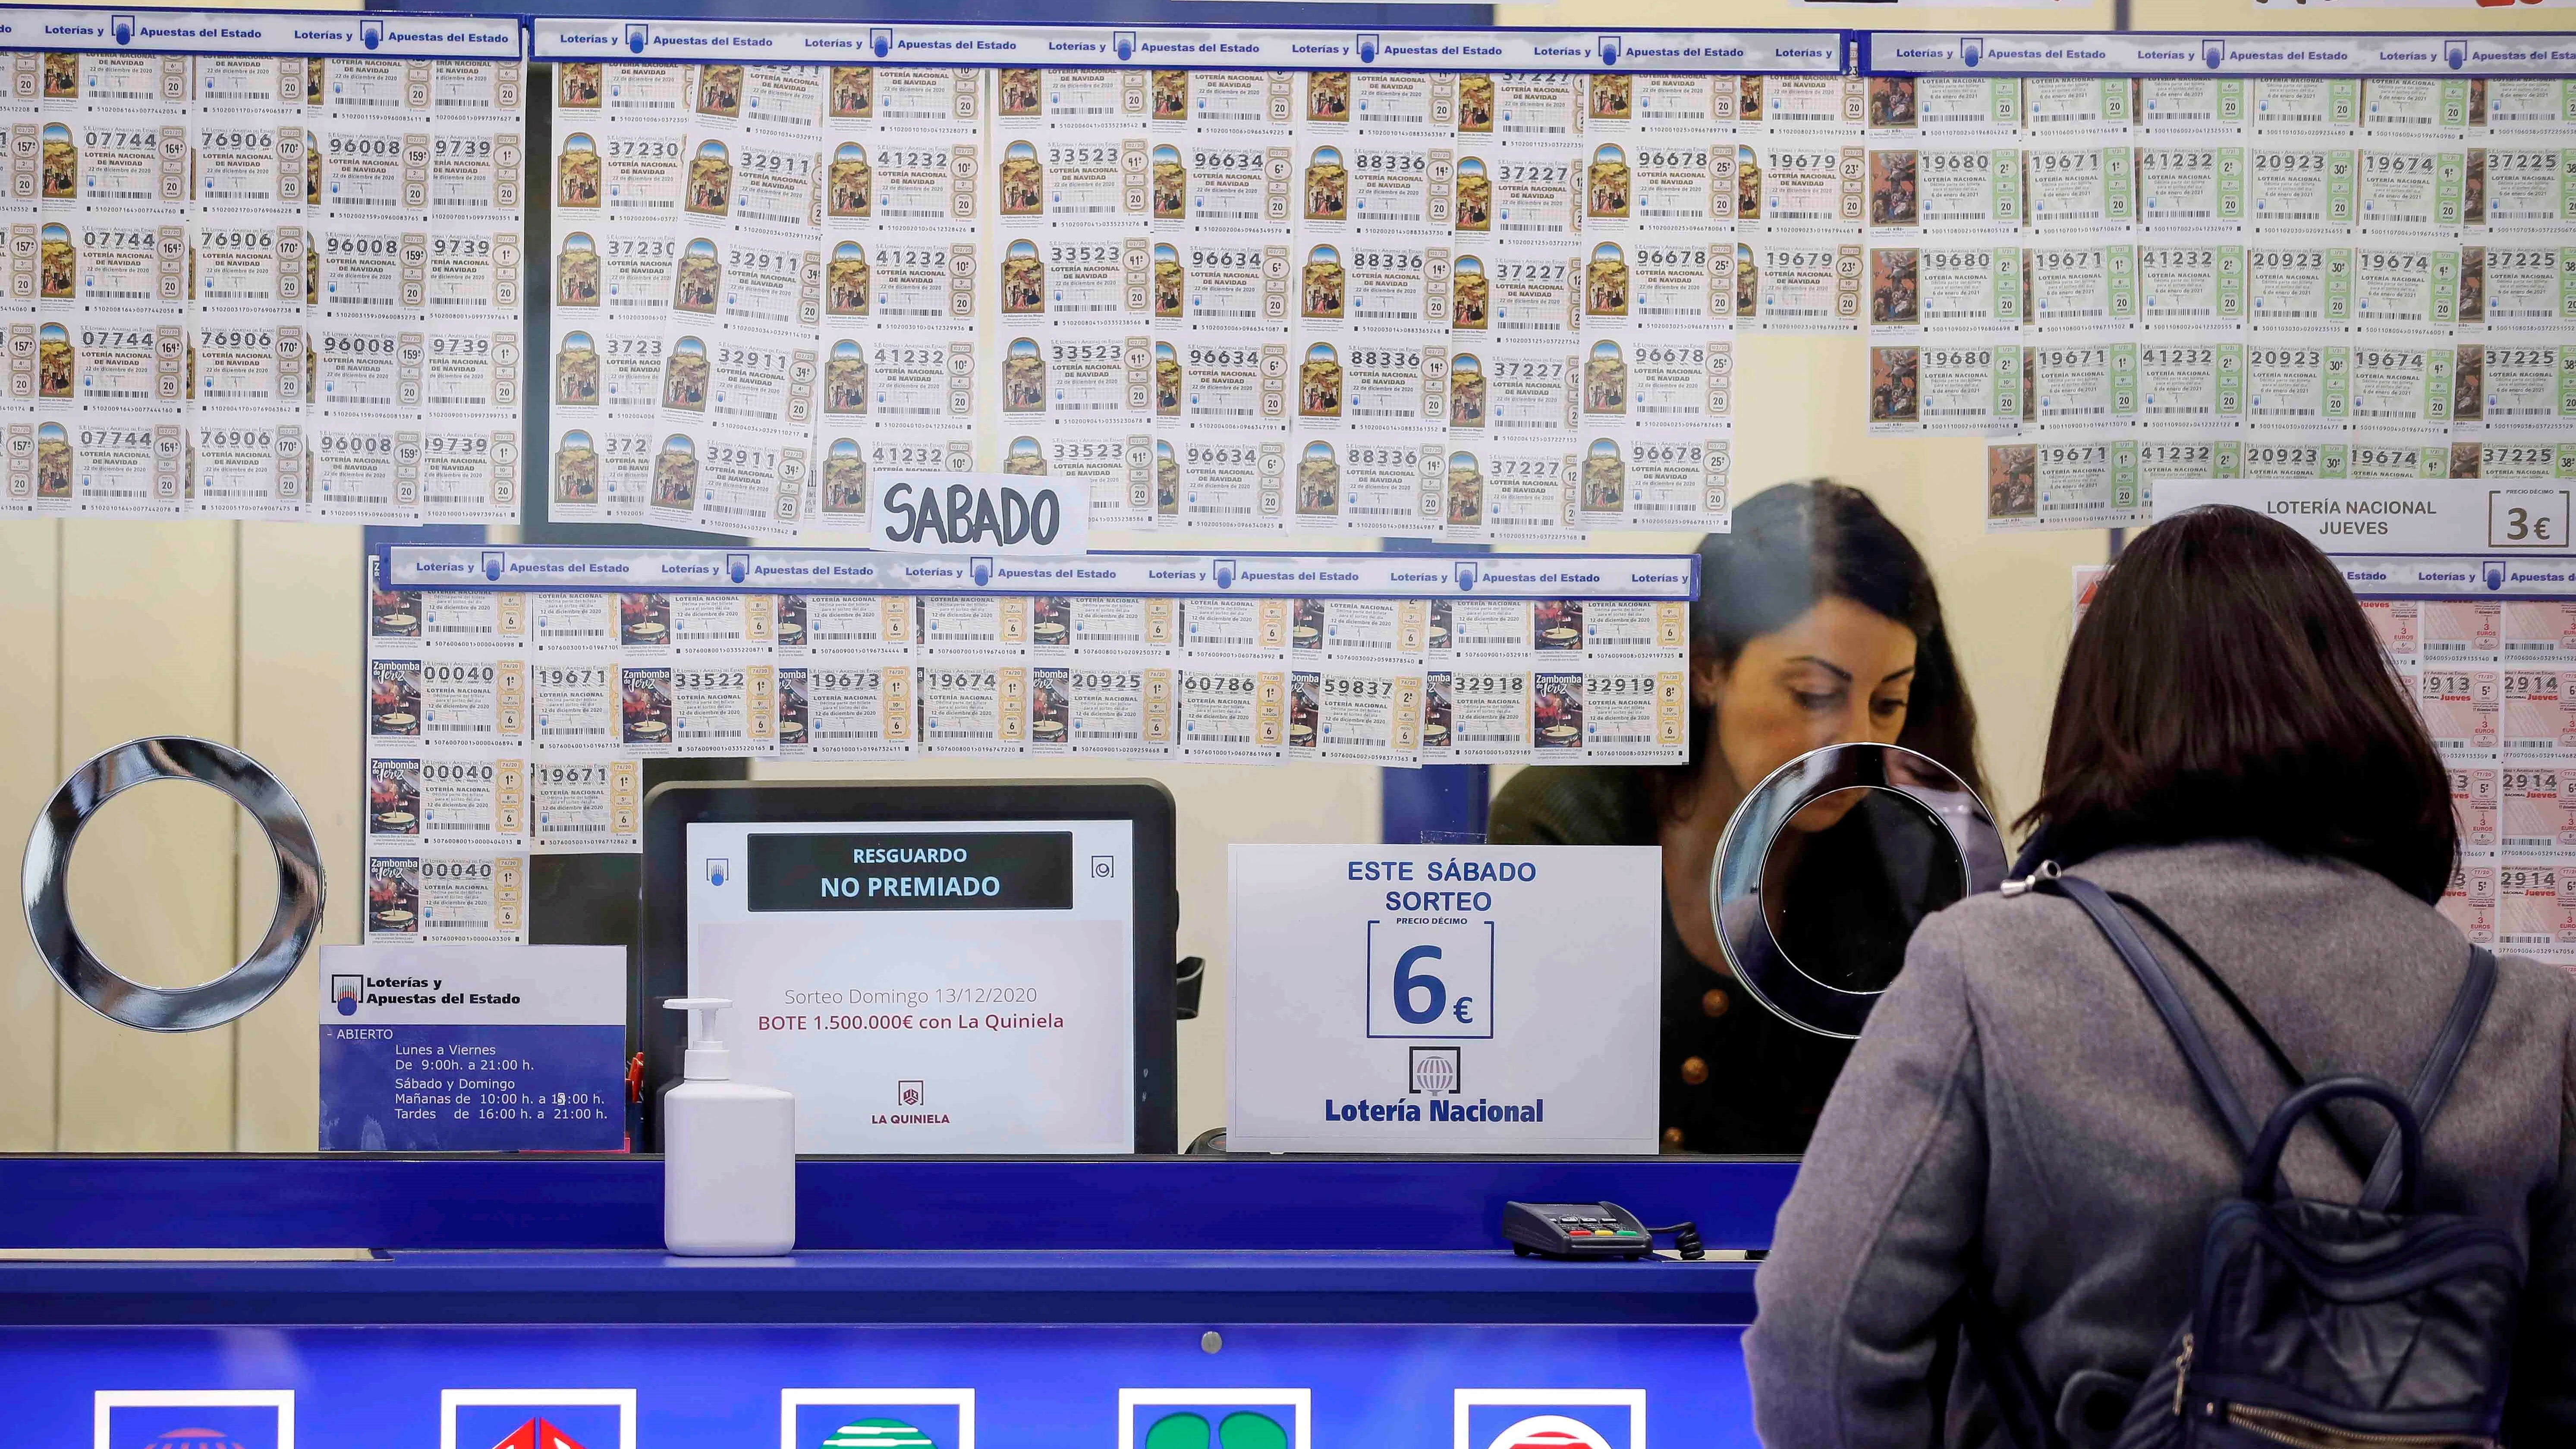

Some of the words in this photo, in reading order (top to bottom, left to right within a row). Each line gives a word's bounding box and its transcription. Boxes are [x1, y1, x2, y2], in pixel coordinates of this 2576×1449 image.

[45, 25, 94, 35] Loterías
[97, 28, 104, 37] y
[140, 27, 195, 38] Apuestas
[199, 28, 217, 37] del
[221, 29, 261, 38] Estado
[560, 35, 608, 43] Loterías
[611, 37, 618, 45] y
[653, 36, 708, 46] Apuestas
[711, 37, 729, 45] del
[733, 38, 772, 46] Estado
[1049, 42, 1096, 50] Loterías
[1100, 44, 1106, 53] y
[1141, 43, 1195, 53] Apuestas
[1199, 44, 1216, 52] del
[1220, 44, 1259, 53] Estado
[1897, 49, 1943, 57] Loterías
[1947, 51, 1953, 60] y
[1988, 49, 2041, 60] Apuestas
[2066, 50, 2106, 59] Estado
[2380, 52, 2427, 60] Loterías
[2431, 54, 2437, 62] y
[85, 132, 157, 147] 07744
[201, 133, 272, 148] 76906
[329, 139, 400, 154] 96008
[609, 141, 679, 156] 37230
[1050, 148, 1118, 163] 33523
[741, 152, 809, 172] 32911
[877, 152, 947, 167] 41232
[1194, 153, 1263, 168] 96634
[1357, 155, 1425, 170] 88336
[1639, 152, 1707, 167] 96678
[1768, 154, 1836, 169] 19679
[1923, 155, 1988, 169] 19680
[2033, 154, 2099, 169] 19671
[2144, 154, 2213, 168] 41232
[2256, 155, 2324, 169] 20923
[2366, 156, 2433, 170] 19674
[2488, 154, 2556, 168] 37225
[1500, 166, 1567, 181] 37227
[82, 332, 153, 347] 07744
[324, 338, 394, 353] 96008
[874, 349, 944, 364] 41232
[1350, 352, 1419, 367] 88336
[1924, 351, 1990, 365] 19680
[2268, 498, 2341, 514] LOTERÍA
[2346, 501, 2437, 514] NACIONAL
[884, 483, 1060, 547] SABADO
[2319, 522, 2388, 535] JUEVES
[2507, 508, 2528, 540] 3
[2534, 517, 2550, 540] €
[662, 564, 709, 573] Loterías
[712, 567, 719, 575] y
[755, 566, 809, 576] Apuestas
[812, 566, 830, 575] del
[834, 566, 874, 575] Estado
[1149, 570, 1196, 579] Loterías
[1199, 573, 1206, 581] y
[1241, 571, 1295, 581] Apuestas
[1298, 572, 1315, 580] del
[1320, 572, 1359, 581] Estado
[374, 661, 420, 671] Zambomba
[377, 670, 406, 682] Jerez
[424, 666, 494, 681] 00040
[539, 671, 605, 684] 19671
[675, 673, 744, 687] 33522
[812, 673, 879, 687] 19673
[928, 674, 996, 687] 19674
[1072, 674, 1140, 688] 20925
[1185, 677, 1254, 691] 60786
[1324, 679, 1392, 695] 59837
[1455, 678, 1523, 691] 32918
[1587, 679, 1654, 691] 32919
[854, 848, 967, 863] RESGUARDO
[422, 864, 492, 877] 00040
[1349, 861, 1413, 881] ESTE
[1428, 858, 1536, 882] SÁBADO
[821, 877, 859, 897] NO
[868, 876, 1000, 897] PREMIADO
[1386, 891, 1491, 911] SORTEO
[367, 977, 428, 987] Loterías
[433, 980, 442, 990] y
[1393, 945, 1446, 1024] 6
[1453, 996, 1473, 1024] €
[366, 993, 436, 1006] Apuestas
[441, 993, 464, 1004] del
[470, 993, 520, 1004] Estado
[785, 990, 843, 1004] Sorteo
[850, 989, 928, 1008] Domingo
[936, 988, 1037, 1003] 13/12/2020
[759, 1016, 806, 1030] BOTE
[814, 1015, 913, 1030] 1.500.000€
[919, 1018, 951, 1029] con
[959, 1015, 978, 1028] La
[985, 1013, 1063, 1031] Quiniela
[337, 1029, 393, 1040] ABIERTO
[396, 1044, 432, 1055] Lunes
[437, 1047, 444, 1055] a
[449, 1045, 496, 1055] Viernes
[396, 1059, 412, 1070] De
[421, 1059, 462, 1070] 9:00h.
[468, 1062, 475, 1070] a
[481, 1059, 517, 1070] 21:00
[523, 1059, 534, 1070] h.
[395, 1077, 442, 1089] Sábado
[447, 1081, 454, 1091] y
[459, 1078, 515, 1091] Domingo
[396, 1093, 451, 1104] Mañanas
[455, 1093, 471, 1104] de
[481, 1094, 517, 1104] 10:00
[522, 1093, 533, 1104] h.
[538, 1096, 546, 1104] a
[593, 1094, 604, 1104] h.
[394, 1108, 436, 1119] Tardes
[454, 1108, 469, 1119] de
[479, 1109, 516, 1119] 16:00
[521, 1108, 532, 1119] h.
[537, 1111, 544, 1119] a
[554, 1109, 591, 1119] 21:00
[596, 1108, 607, 1119] h.
[1326, 1098, 1420, 1122] Lotería
[1430, 1098, 1543, 1122] Nacional
[872, 1115, 887, 1124] LA
[890, 1114, 950, 1124] QUINIELA
